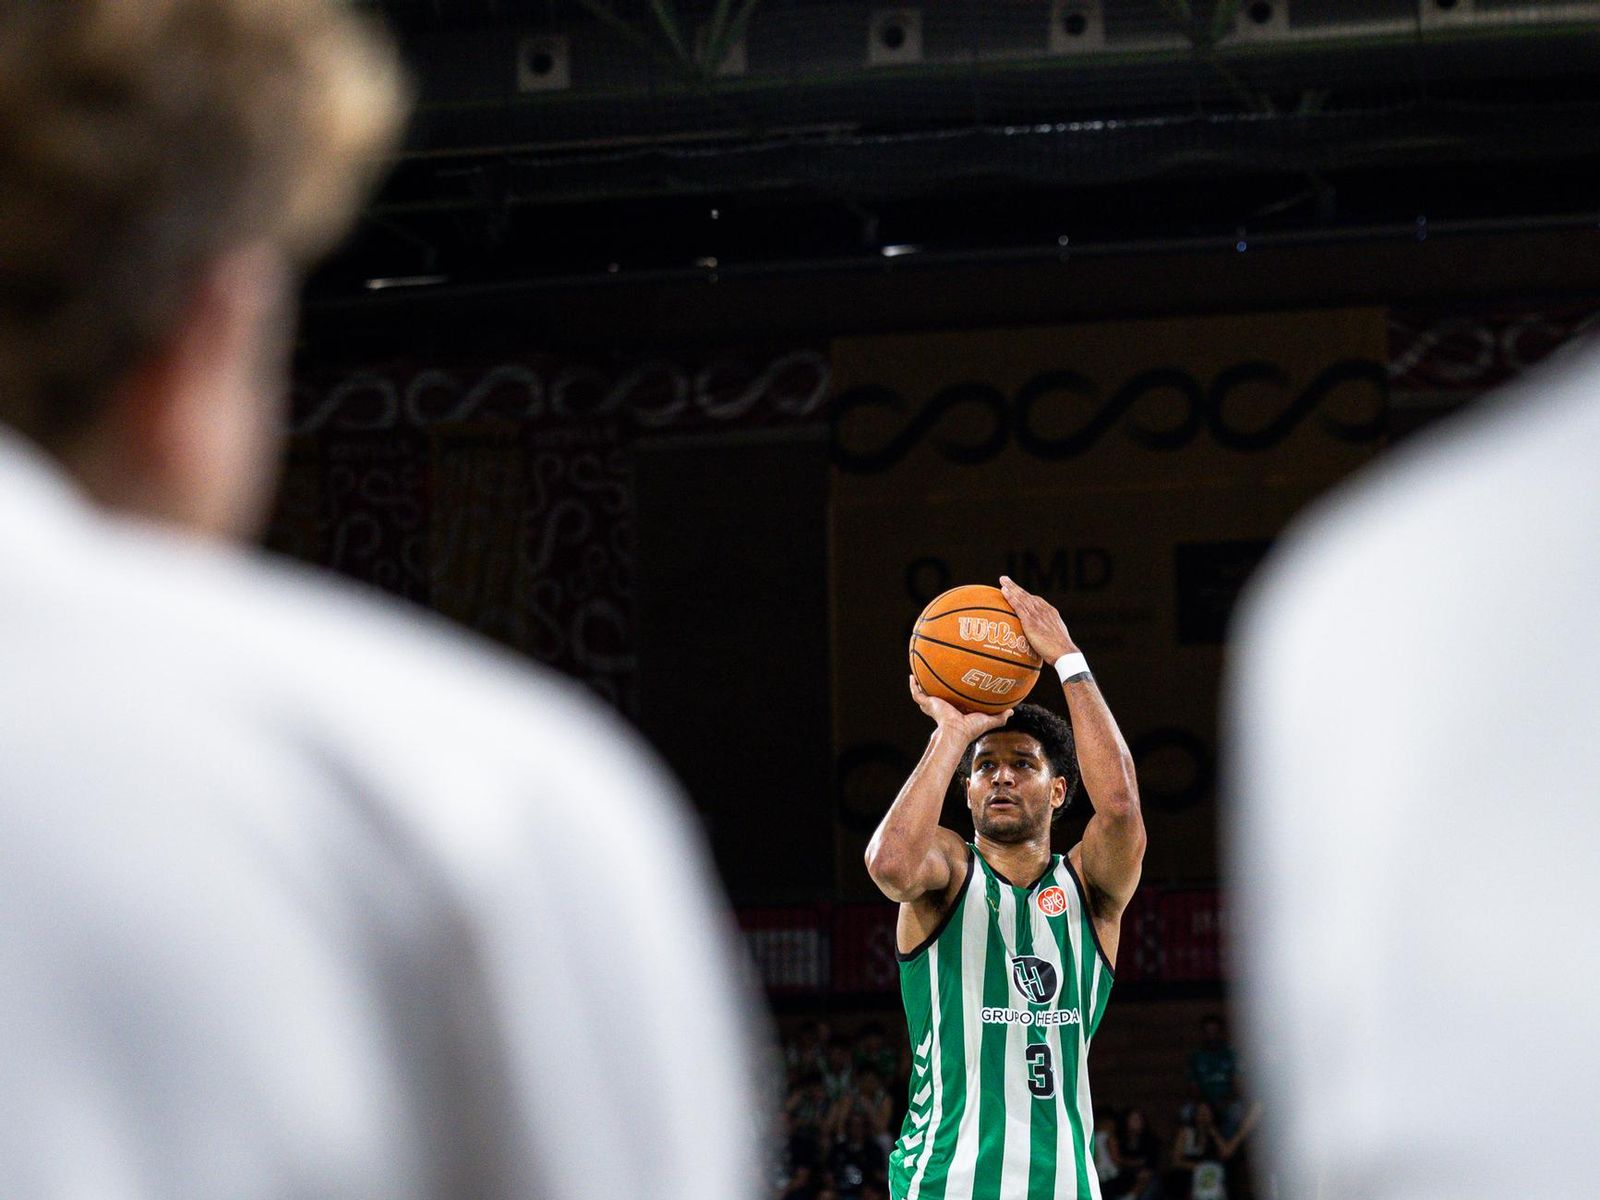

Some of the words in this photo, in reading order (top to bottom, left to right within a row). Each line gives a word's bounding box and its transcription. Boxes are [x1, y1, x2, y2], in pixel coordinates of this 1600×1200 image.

[958, 616, 1037, 660] Wilso
[981, 1009, 1032, 1024] GRUPO
[1036, 1010, 1079, 1025] HEEDA
[1025, 1043, 1056, 1099] 3
